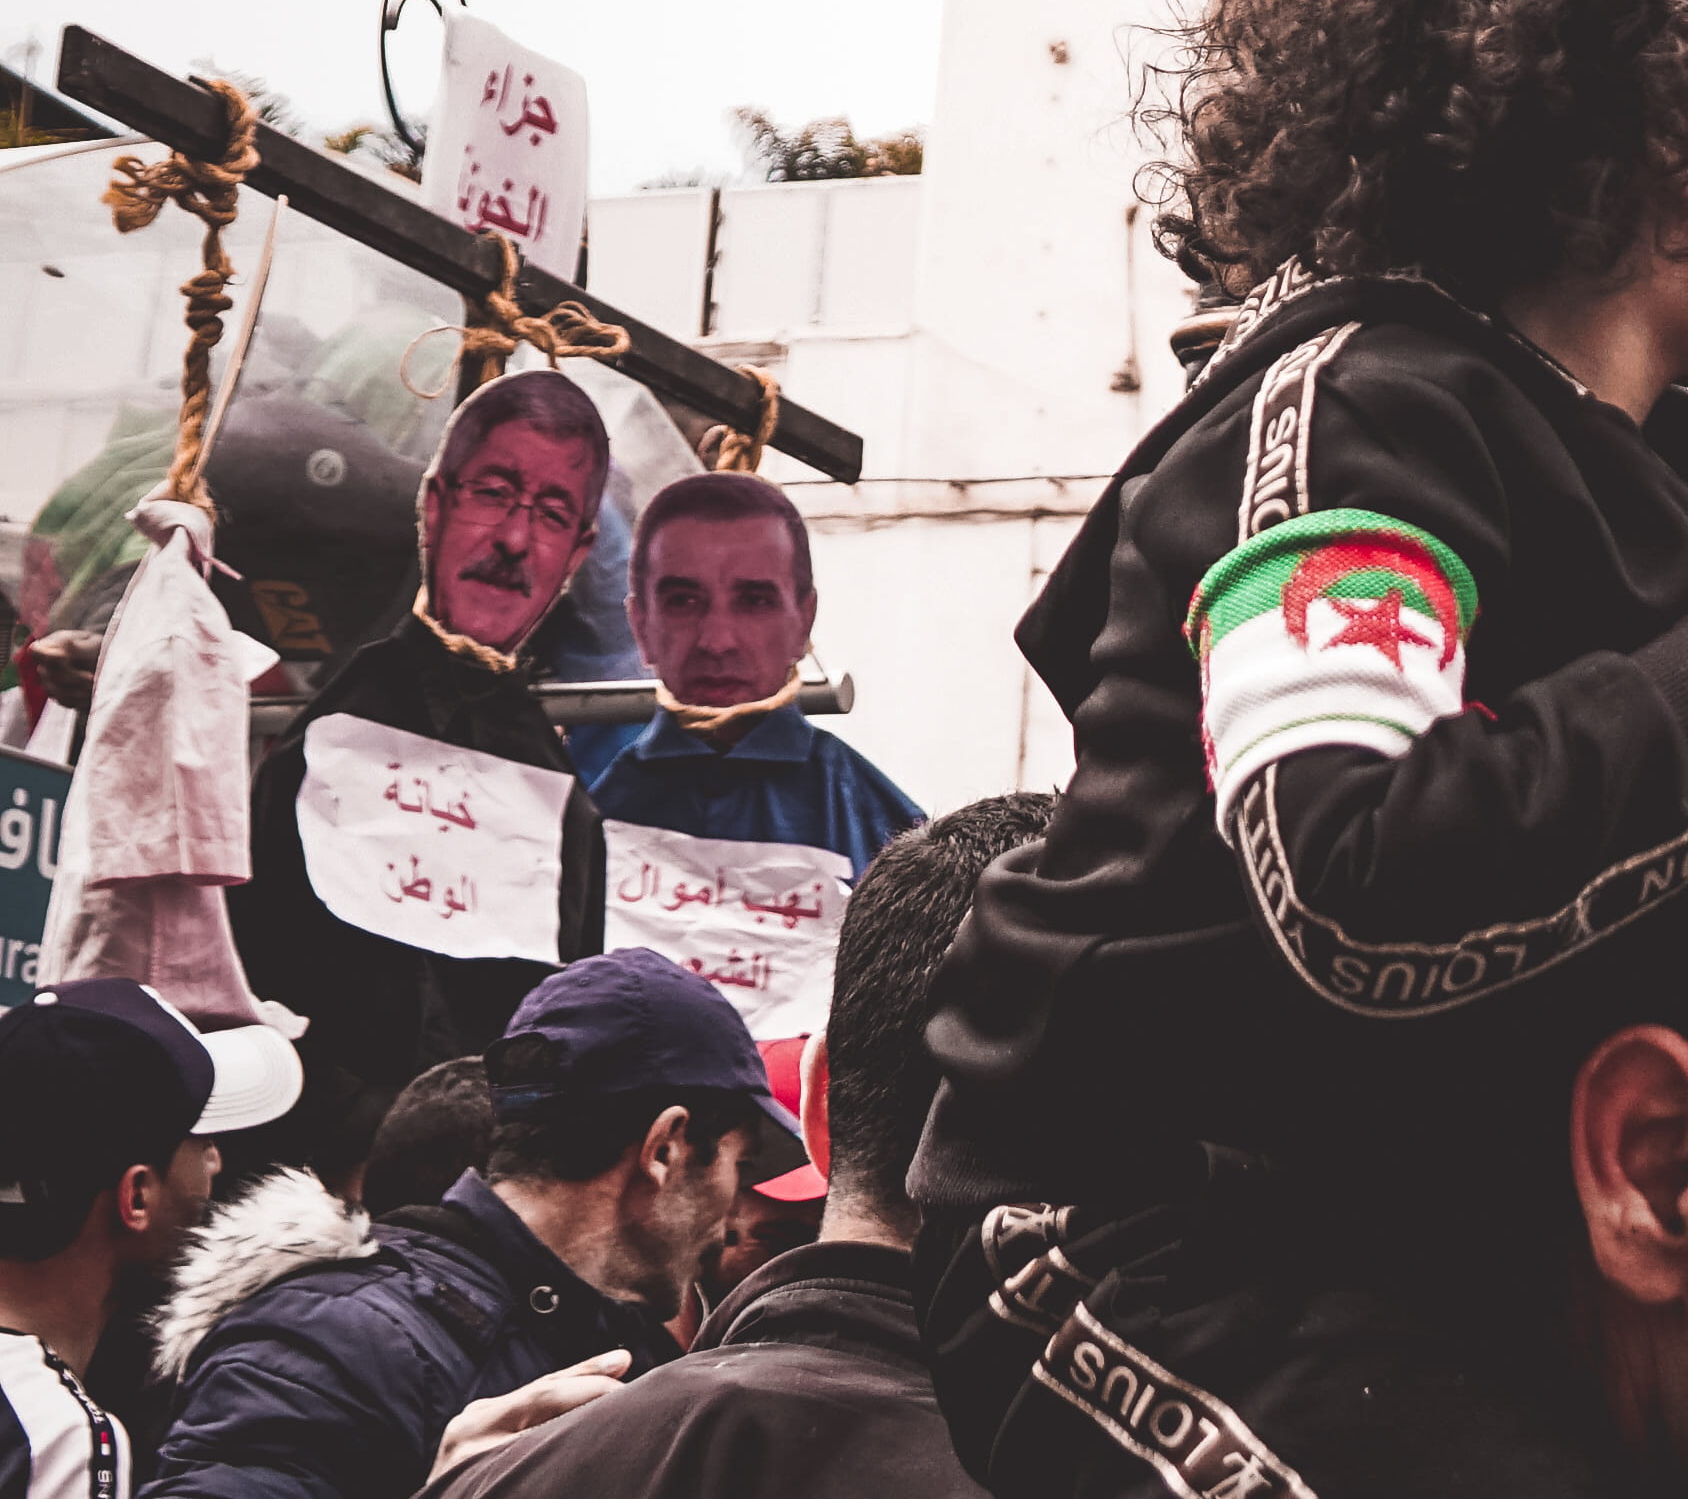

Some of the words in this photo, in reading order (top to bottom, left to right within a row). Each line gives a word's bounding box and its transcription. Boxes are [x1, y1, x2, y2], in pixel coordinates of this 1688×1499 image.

[480, 62, 559, 147] جزاء
[1250, 406, 1298, 535] OIUS
[384, 762, 477, 832] خيانة
[382, 854, 478, 919] الوطن
[741, 882, 823, 930] نهب
[682, 949, 770, 992] الشع
